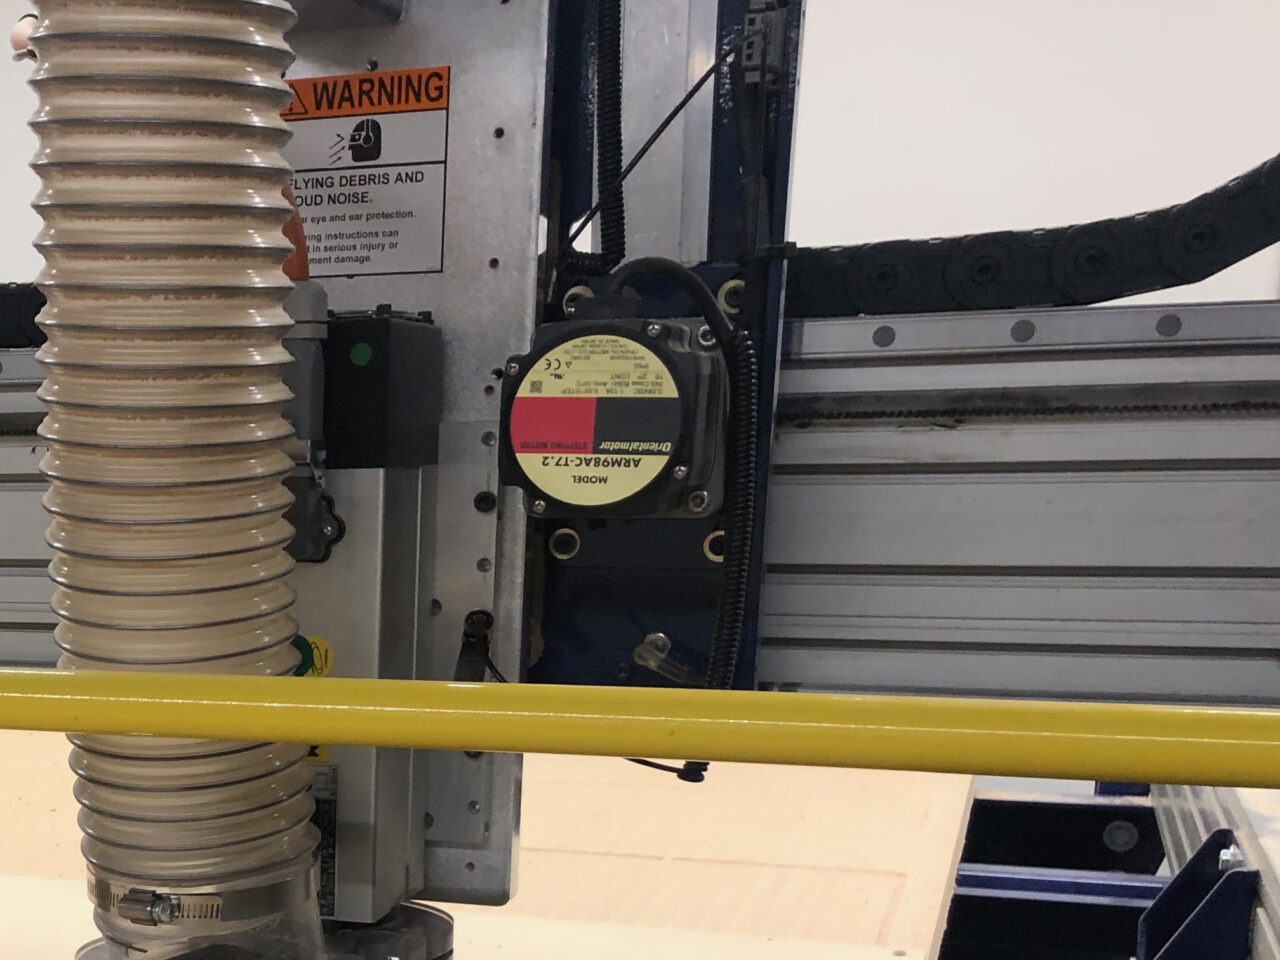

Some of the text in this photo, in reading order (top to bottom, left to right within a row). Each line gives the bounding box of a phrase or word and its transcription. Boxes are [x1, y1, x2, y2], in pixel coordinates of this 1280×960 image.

[312, 71, 443, 111] WARNING
[339, 172, 390, 187] DEBRIS
[394, 170, 424, 184] AND
[295, 191, 372, 207] OUD NOISE.
[310, 215, 327, 225] eye
[329, 213, 346, 223] and
[349, 213, 363, 222] ear
[382, 229, 399, 238] can
[312, 245, 321, 253] in
[323, 244, 357, 253] serious
[360, 243, 387, 254] injury
[389, 241, 399, 250] or
[541, 456, 642, 468] ARM98AC-T7.2
[571, 475, 608, 484] MODEL
